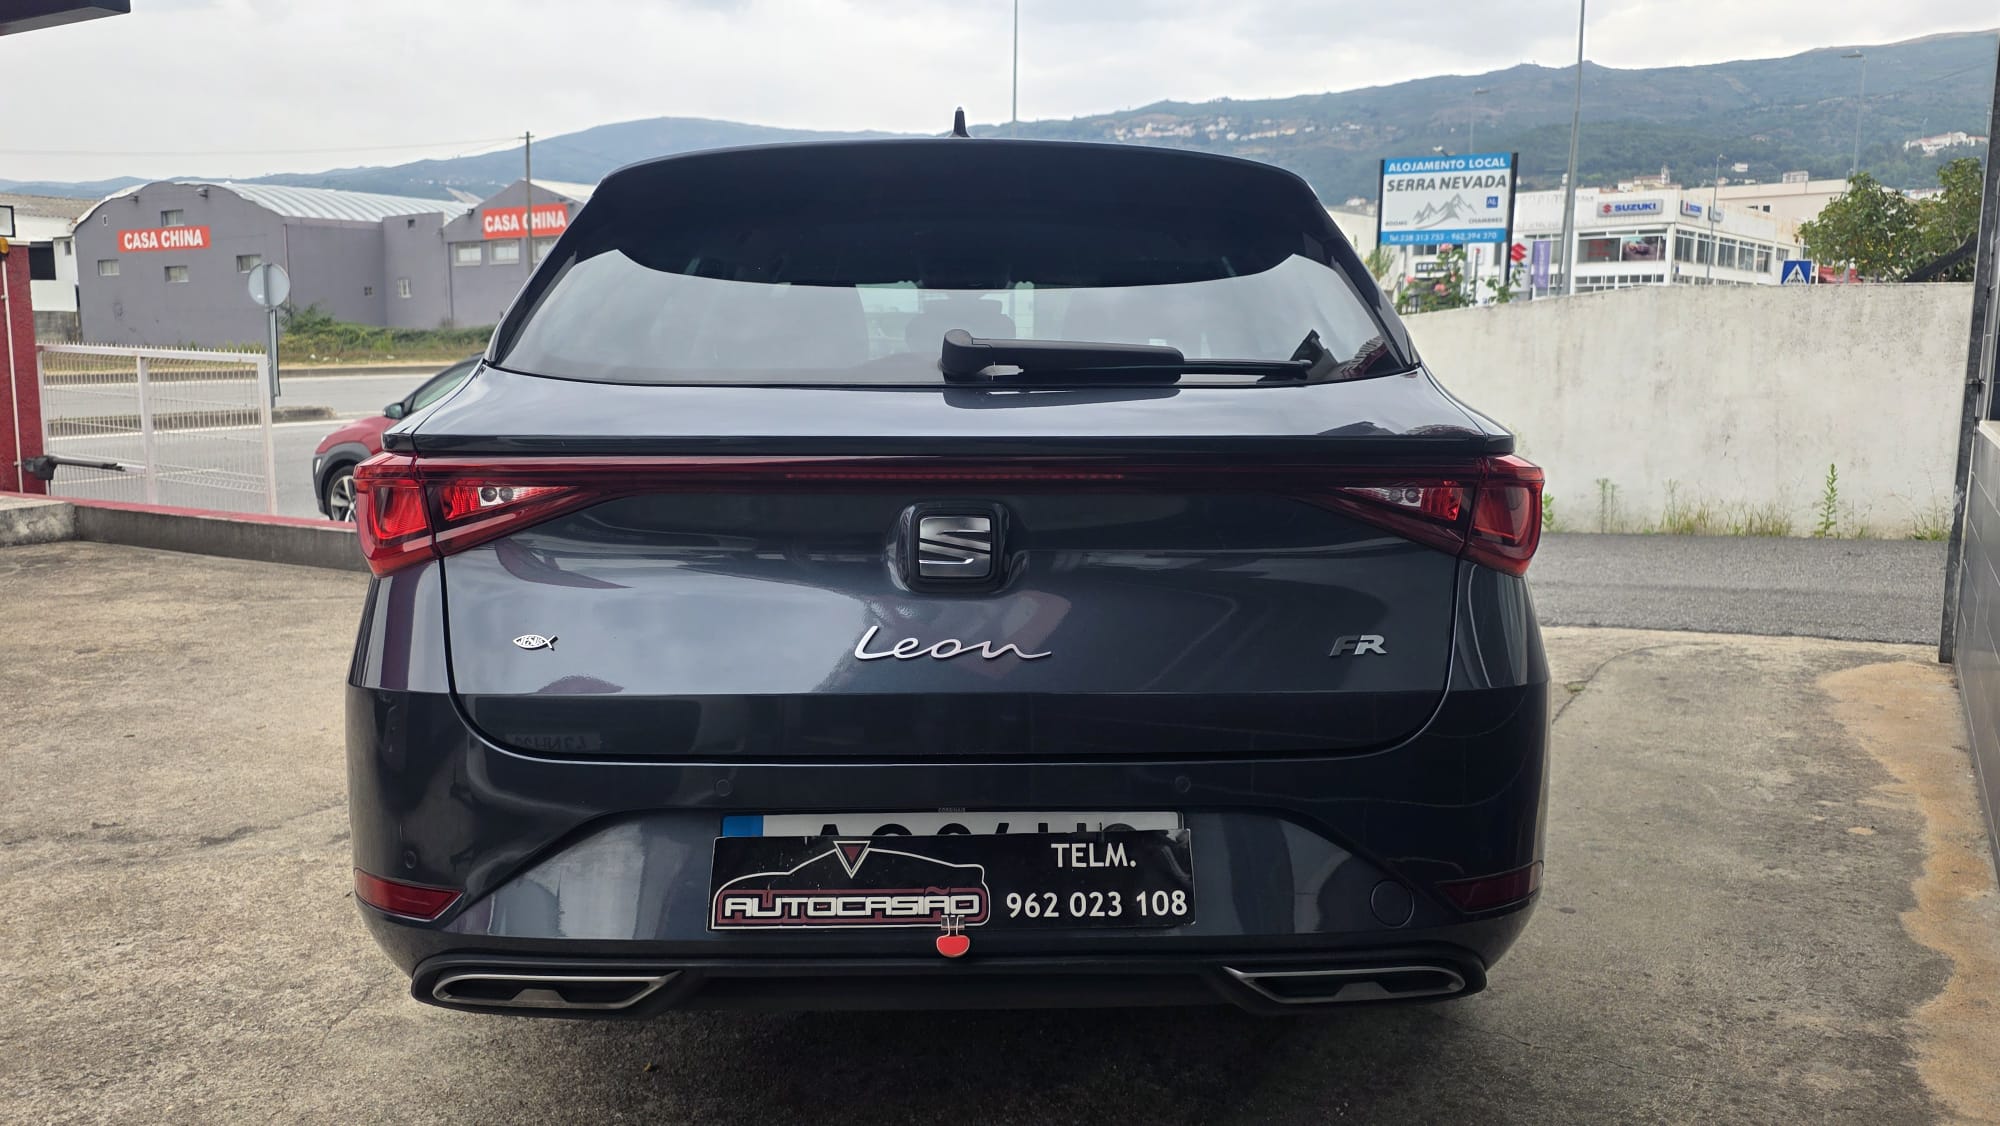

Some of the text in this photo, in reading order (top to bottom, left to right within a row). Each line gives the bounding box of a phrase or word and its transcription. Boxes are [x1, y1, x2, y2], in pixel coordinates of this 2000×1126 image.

[1388, 158, 1506, 172] ALOJAMENTO LOCAL
[1386, 175, 1507, 192] SERRA NEVADA
[1614, 202, 1657, 212] SUZUKI
[484, 210, 567, 233] CASA CHINA
[124, 228, 204, 250] CASA CHINA
[854, 625, 1052, 660] Leon
[1329, 634, 1388, 657] FR
[1050, 842, 1137, 868] TELM.
[724, 886, 980, 917] AUTOCASIÃO
[1006, 890, 1188, 918] 962 023 108
